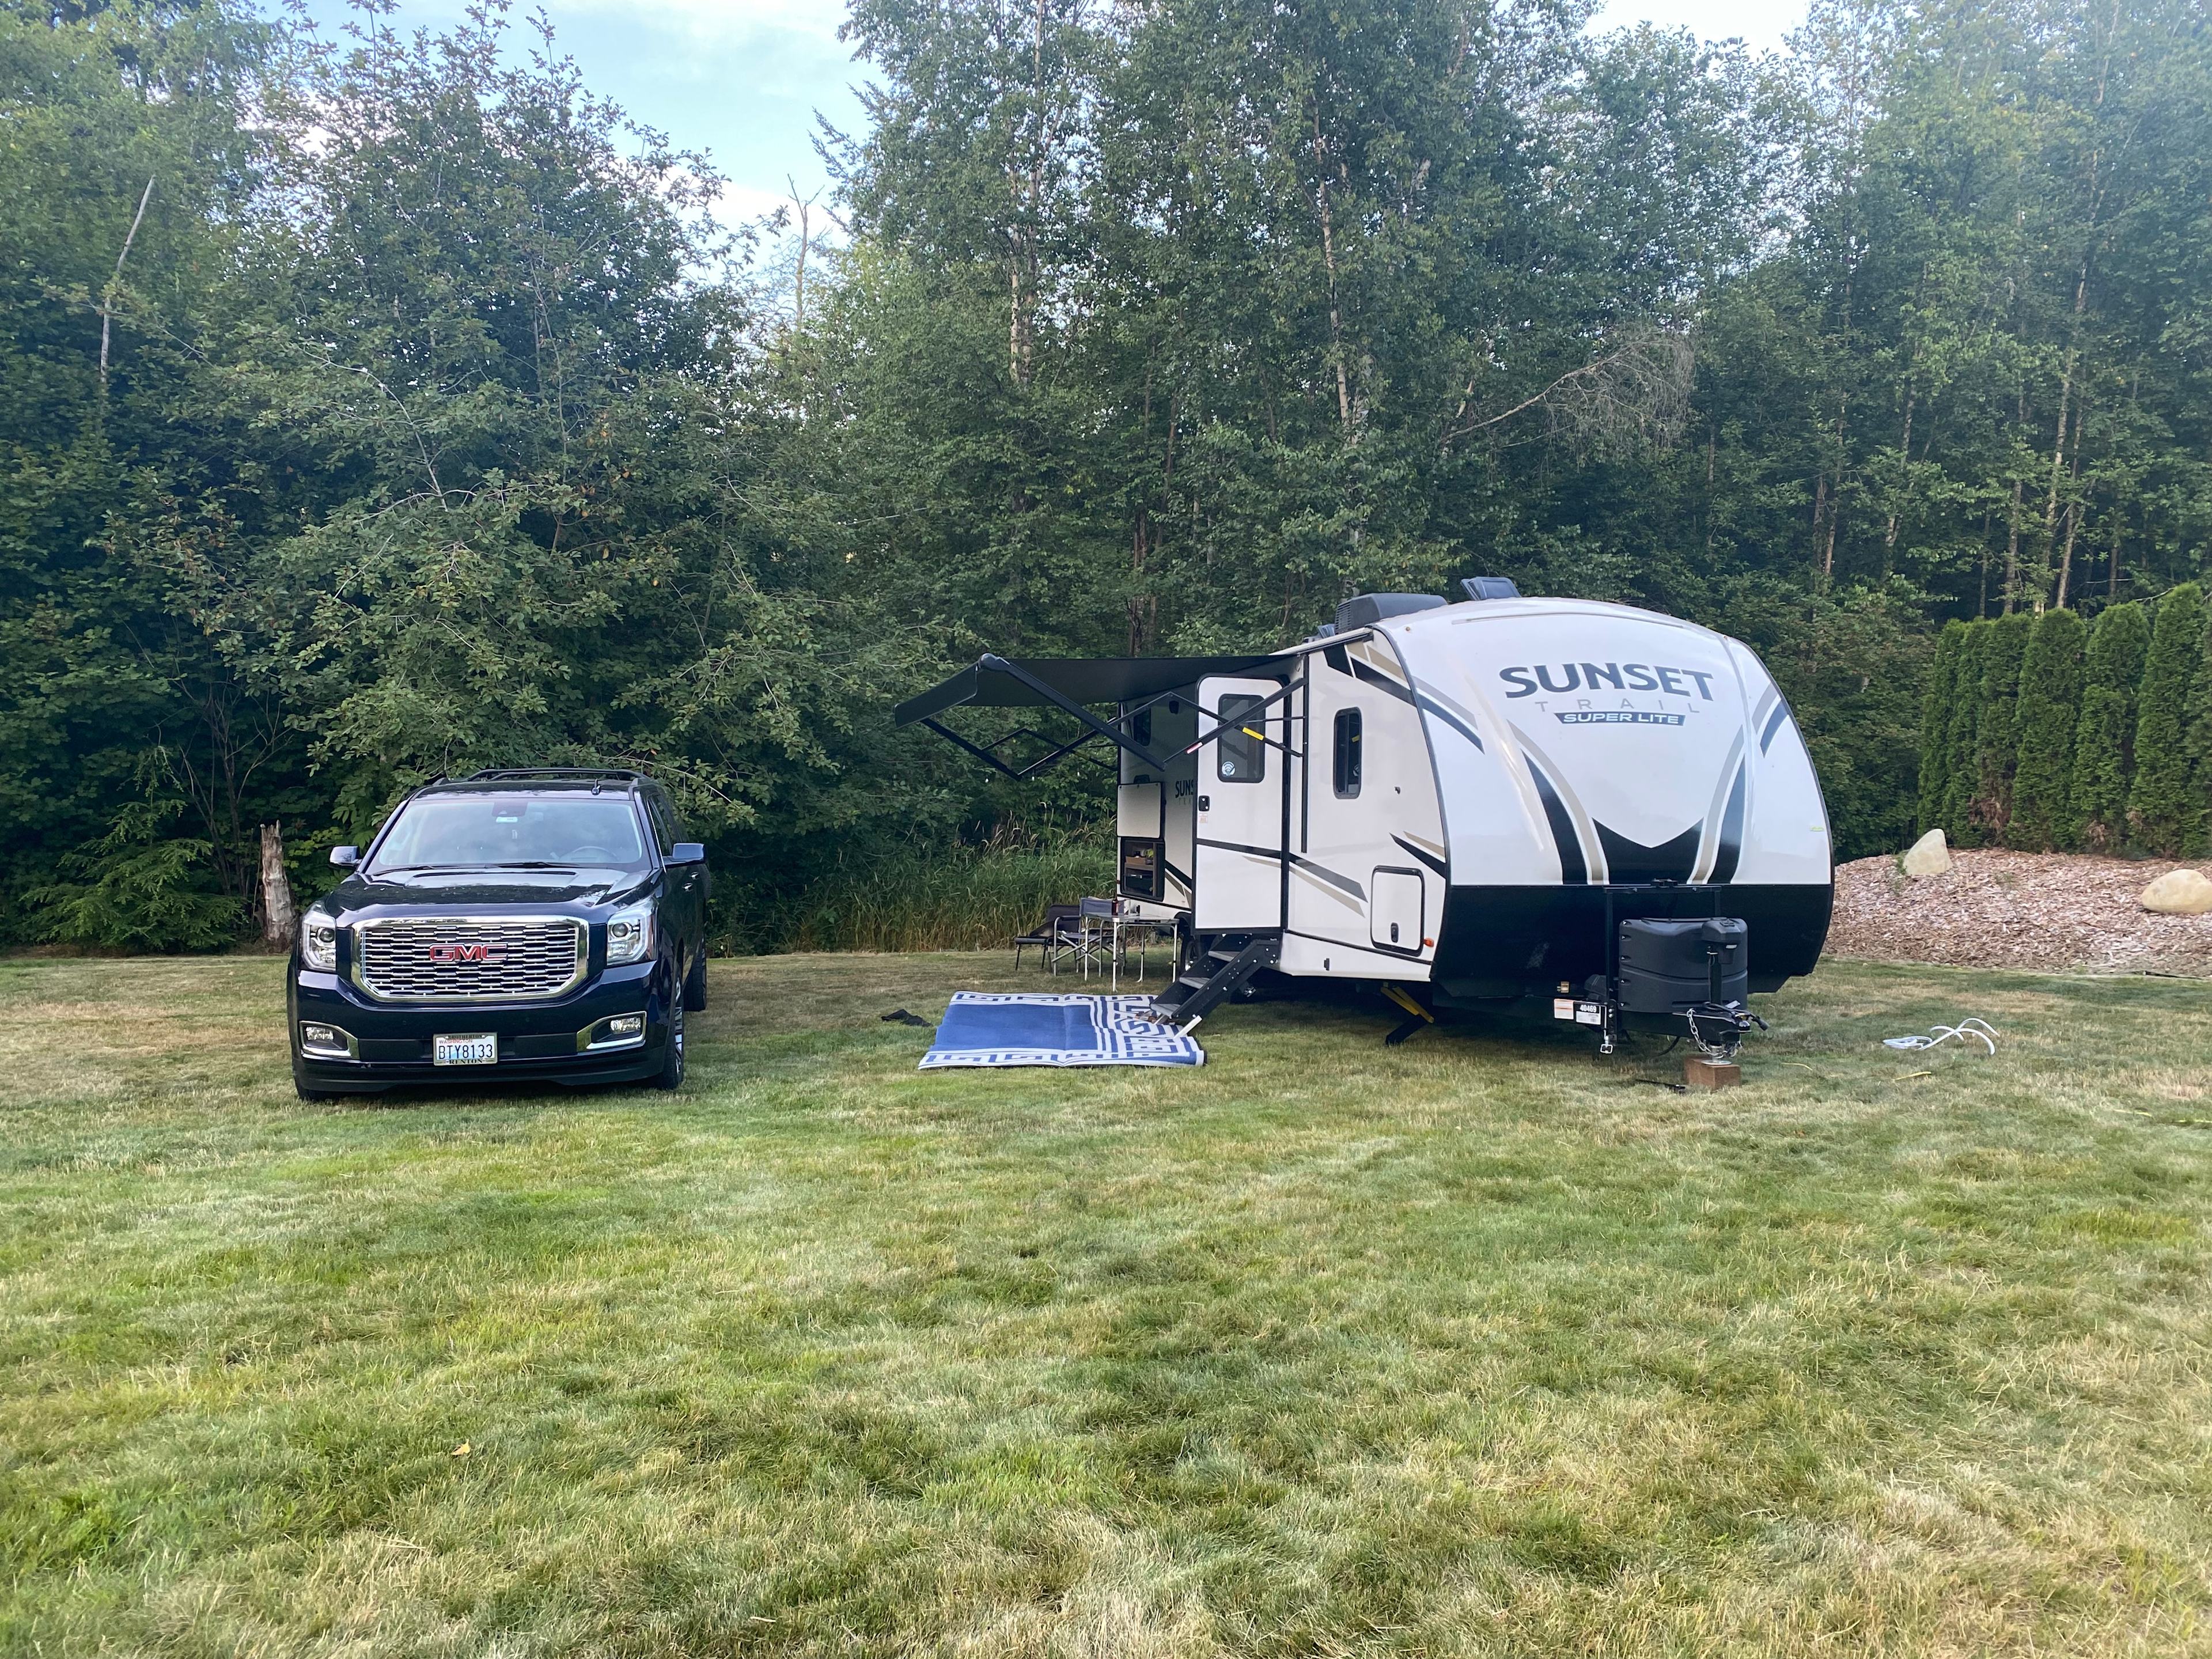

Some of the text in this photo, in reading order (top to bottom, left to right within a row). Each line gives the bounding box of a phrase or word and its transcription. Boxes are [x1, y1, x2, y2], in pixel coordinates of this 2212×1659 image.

[1499, 662, 1714, 702] SUNSET
[1535, 698, 1700, 713] TRAIL
[1563, 713, 1679, 725] SUPER LITE
[429, 942, 508, 962] GMC
[1580, 1004, 1597, 1013] 40469
[439, 1044, 493, 1059] BTY8133
